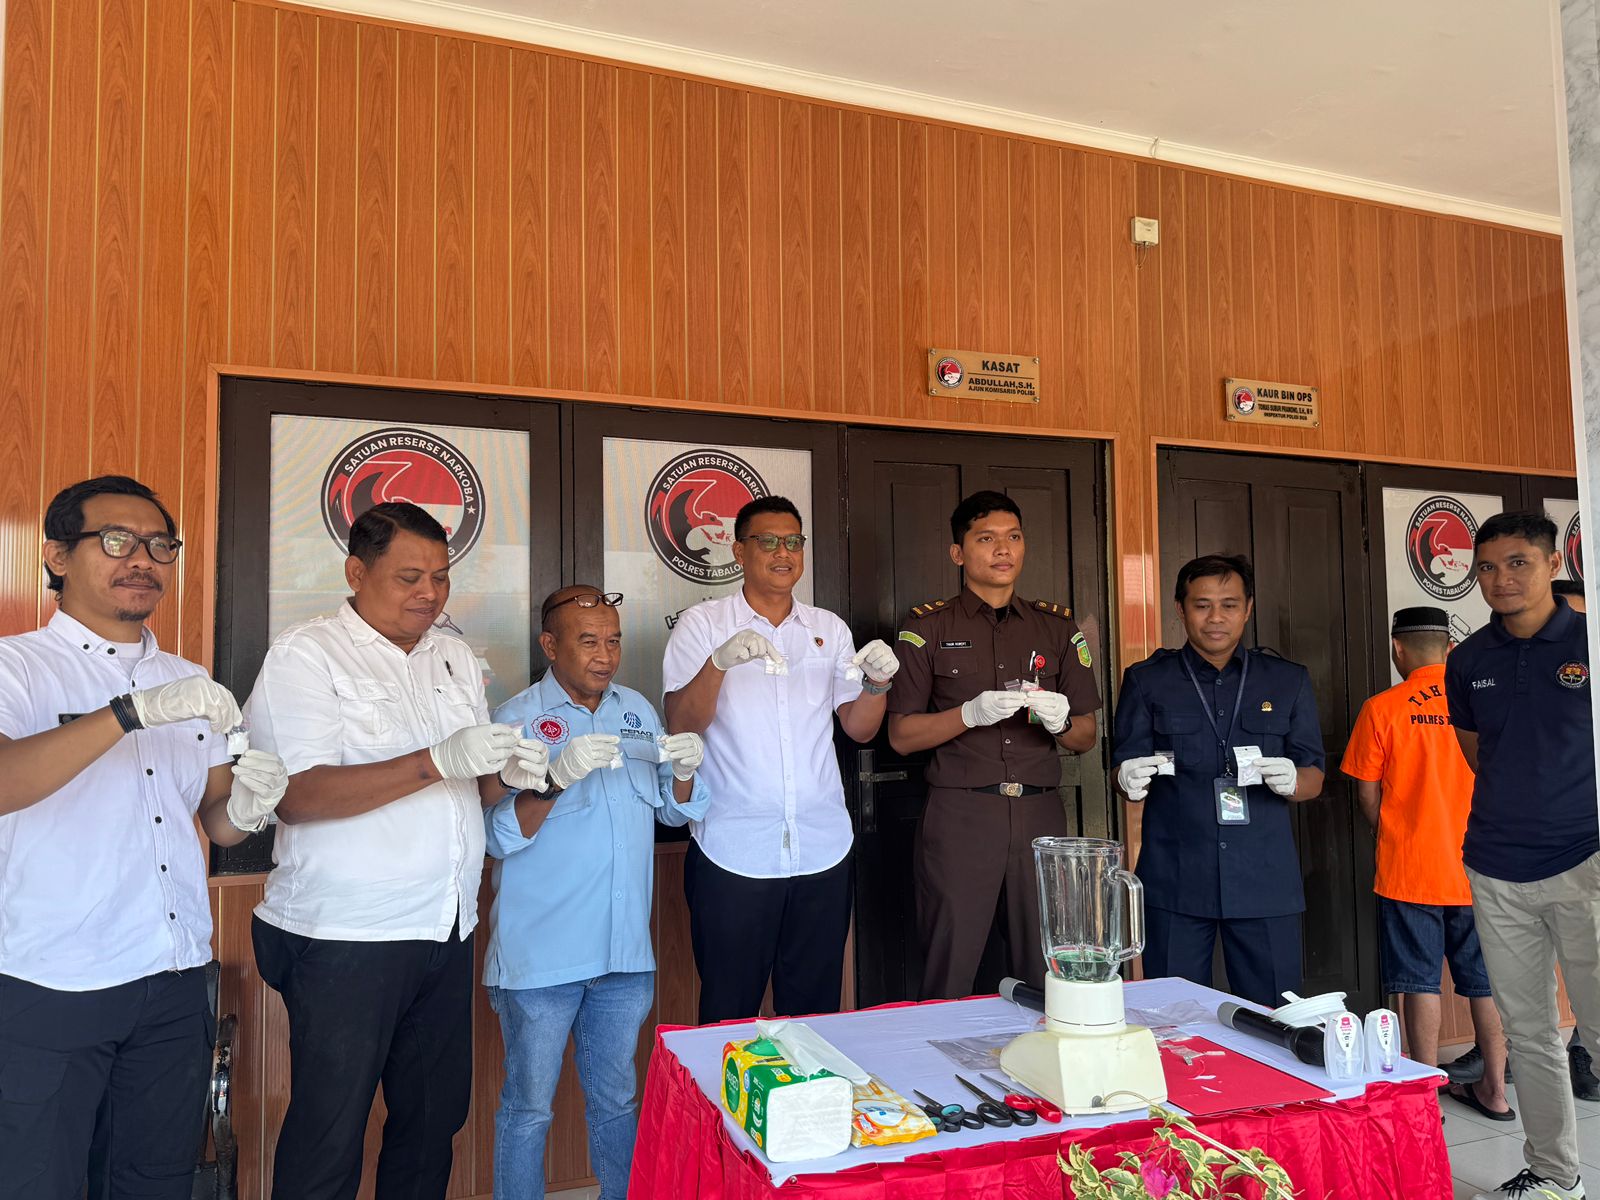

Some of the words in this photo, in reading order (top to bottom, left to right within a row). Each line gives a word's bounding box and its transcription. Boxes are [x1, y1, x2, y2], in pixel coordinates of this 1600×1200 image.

[982, 360, 1020, 373] KASAT
[968, 378, 1035, 390] ABDULLAH,S.H.
[985, 386, 1016, 395] KOMISARIS
[1017, 388, 1035, 396] POLISI
[1257, 388, 1279, 399] KAUR
[1281, 390, 1295, 400] BIN
[1296, 392, 1312, 402] OPS
[344, 438, 388, 473] SATUAN
[389, 436, 441, 454] RESERSE
[439, 451, 475, 503] NARKOBA
[662, 459, 697, 490] SATUAN
[698, 456, 740, 473] RESERSE
[738, 469, 763, 500] NARKO
[1415, 503, 1437, 527] SATUAN
[1435, 501, 1461, 514] RESERSE
[671, 555, 704, 577] POLRES
[706, 564, 743, 577] TABALO
[1422, 577, 1443, 595] POLRES
[1443, 578, 1472, 596] TABALONG
[1472, 678, 1496, 690] FAISAL
[1410, 714, 1445, 726] POLRES
